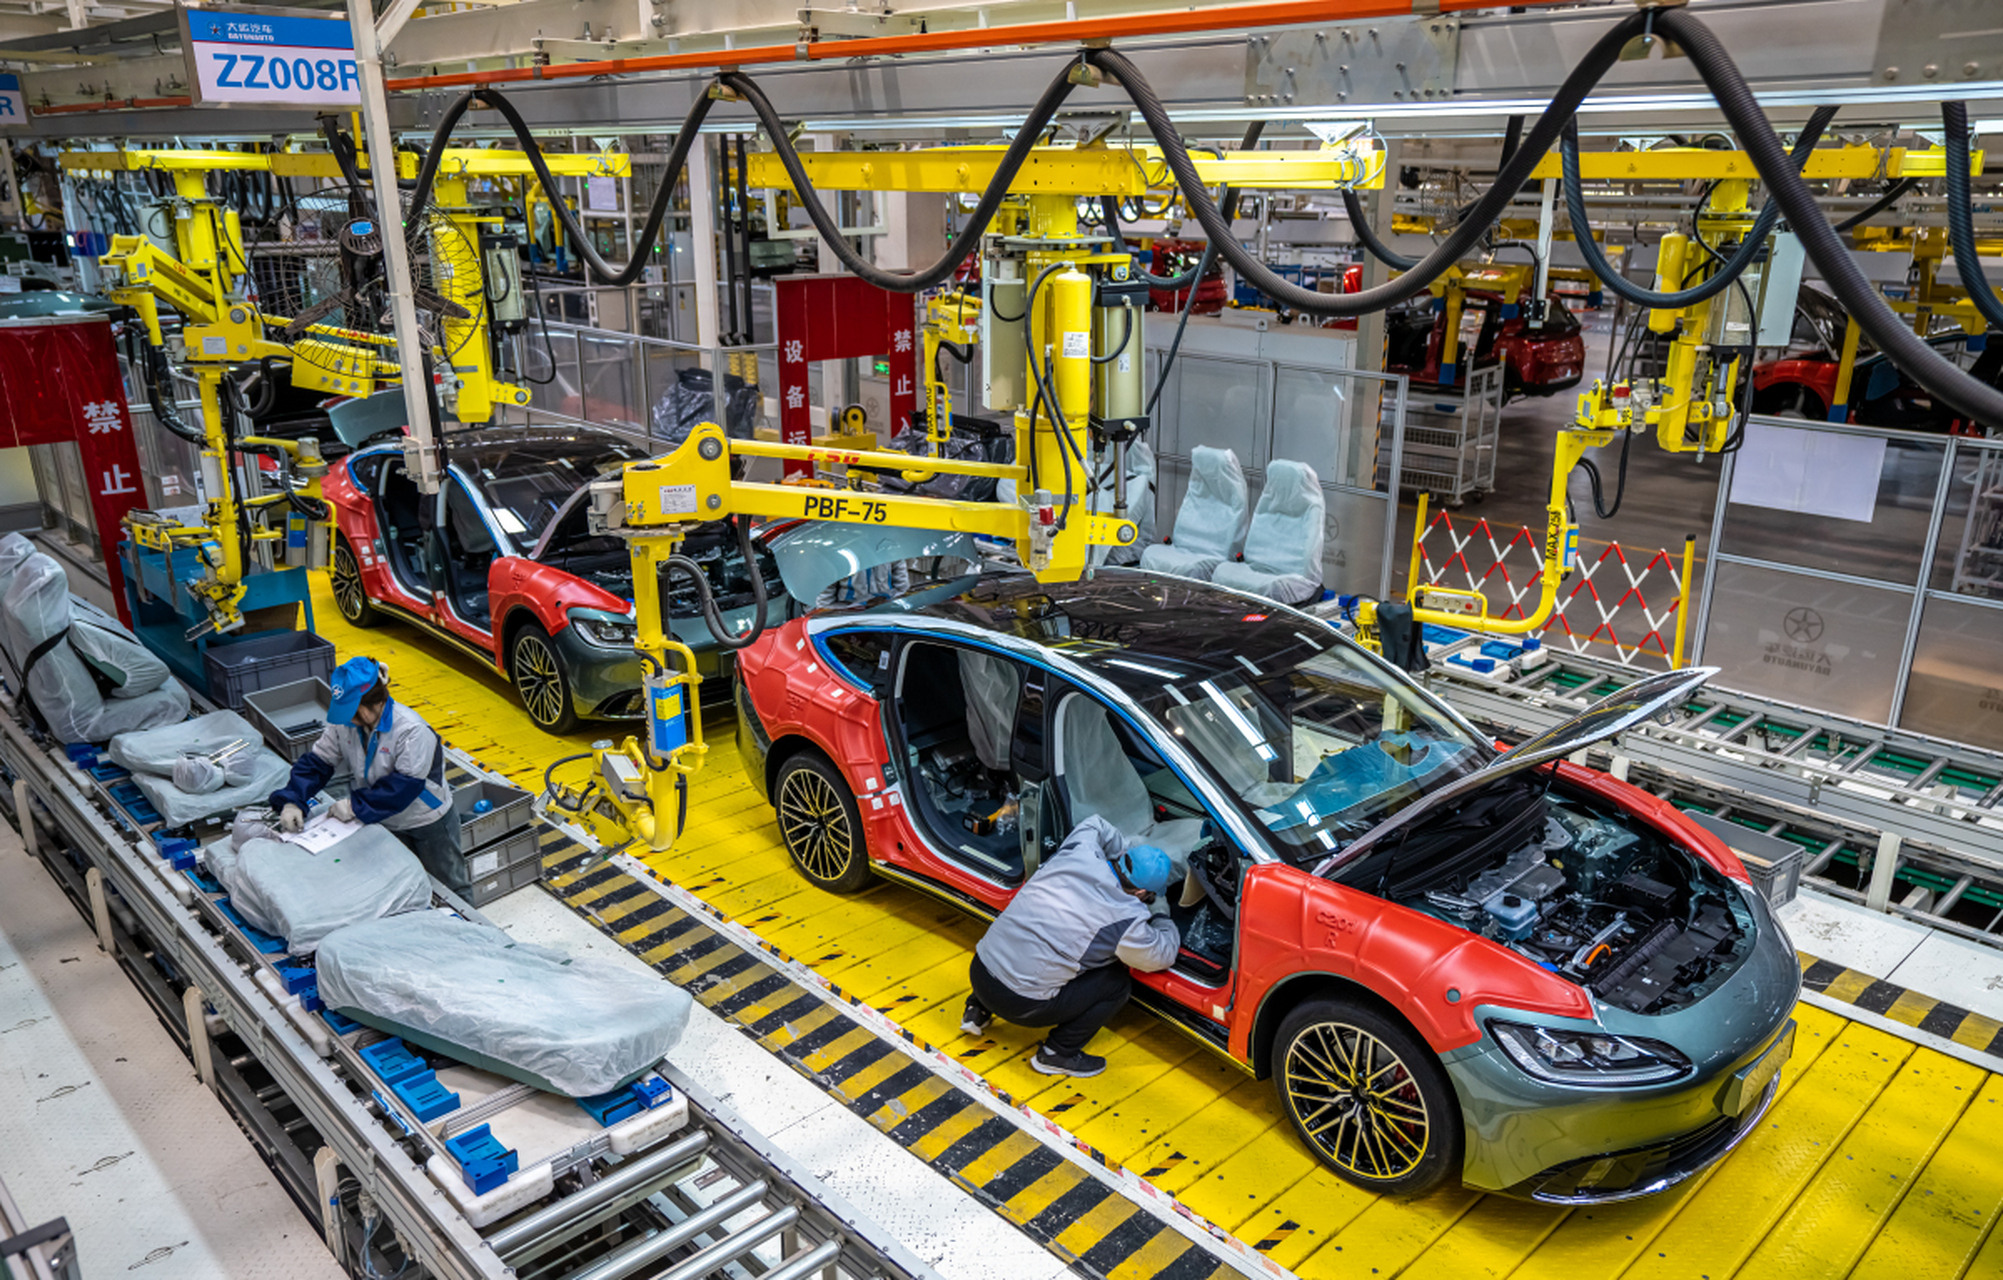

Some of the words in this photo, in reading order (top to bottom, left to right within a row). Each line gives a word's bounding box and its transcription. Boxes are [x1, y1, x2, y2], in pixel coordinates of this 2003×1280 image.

[226, 22, 273, 34] 大运汽车
[212, 52, 361, 92] ZZ008R
[82, 400, 138, 496] 禁止
[803, 495, 888, 523] PBF-75
